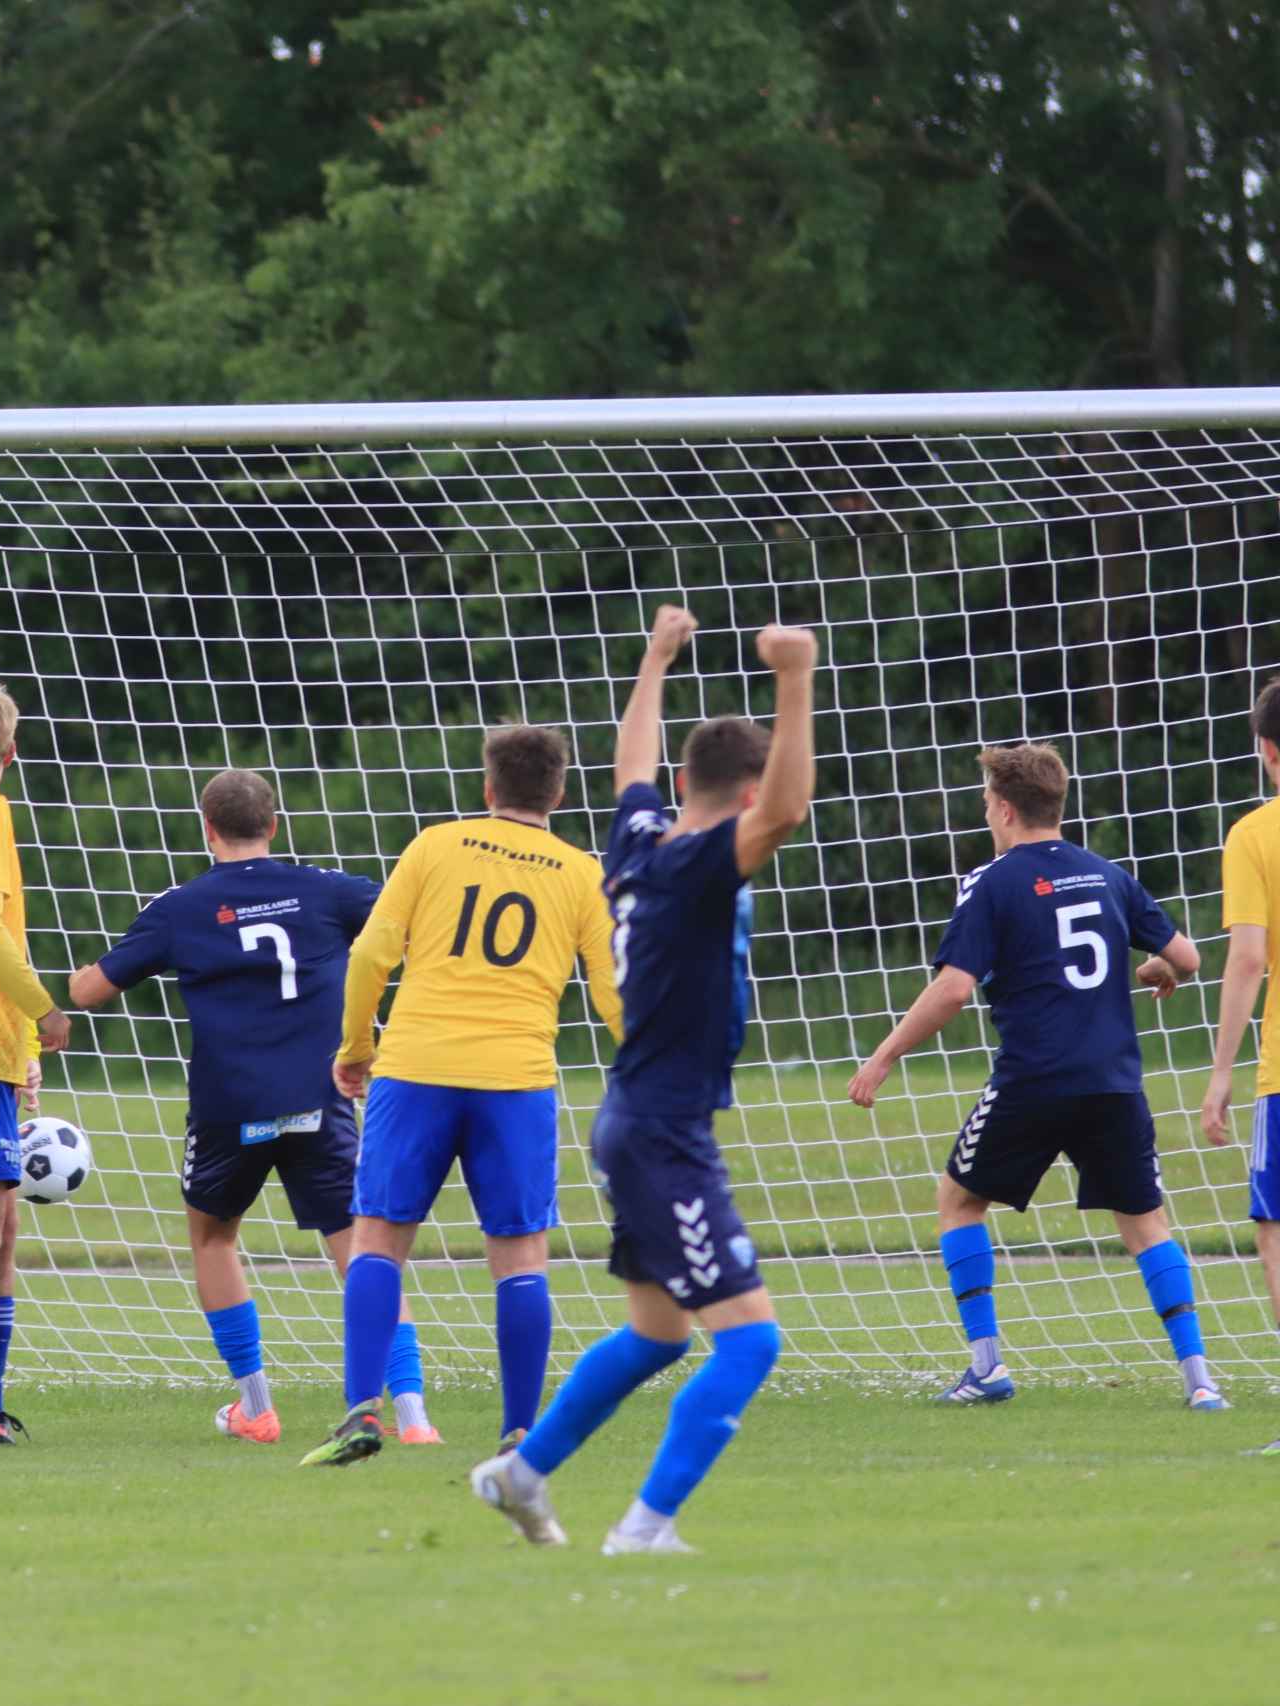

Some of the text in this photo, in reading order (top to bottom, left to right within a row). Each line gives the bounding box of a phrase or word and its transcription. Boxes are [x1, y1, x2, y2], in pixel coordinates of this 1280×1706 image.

[462, 838, 562, 869] SPORTMASTER
[239, 923, 298, 1000] 7
[448, 884, 536, 967] 10
[1056, 901, 1109, 990] 5
